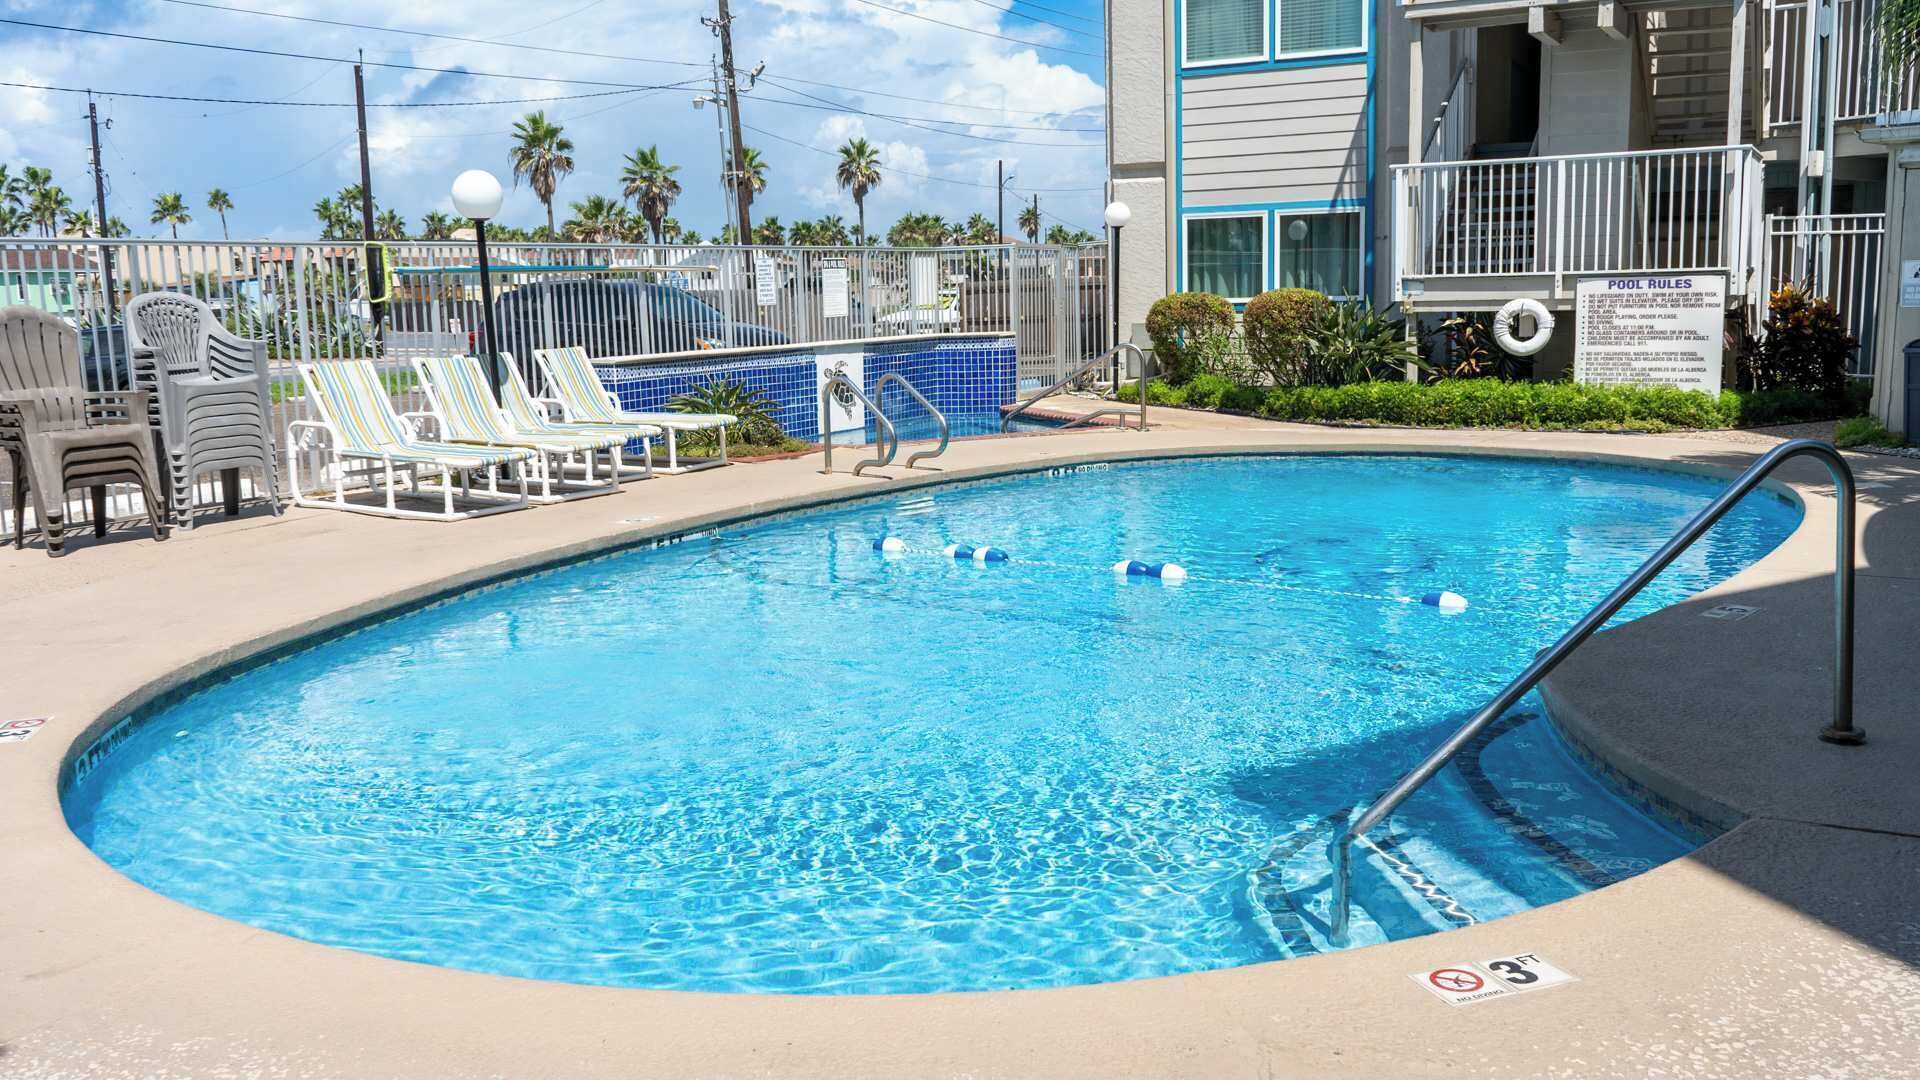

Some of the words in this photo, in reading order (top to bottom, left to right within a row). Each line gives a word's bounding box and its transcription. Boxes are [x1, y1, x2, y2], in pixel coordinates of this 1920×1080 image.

[1608, 280, 1643, 290] POOL
[1648, 279, 1692, 289] RULES
[1514, 953, 1540, 966] FT
[1489, 960, 1538, 985] 3
[1472, 989, 1504, 999] DIVING
